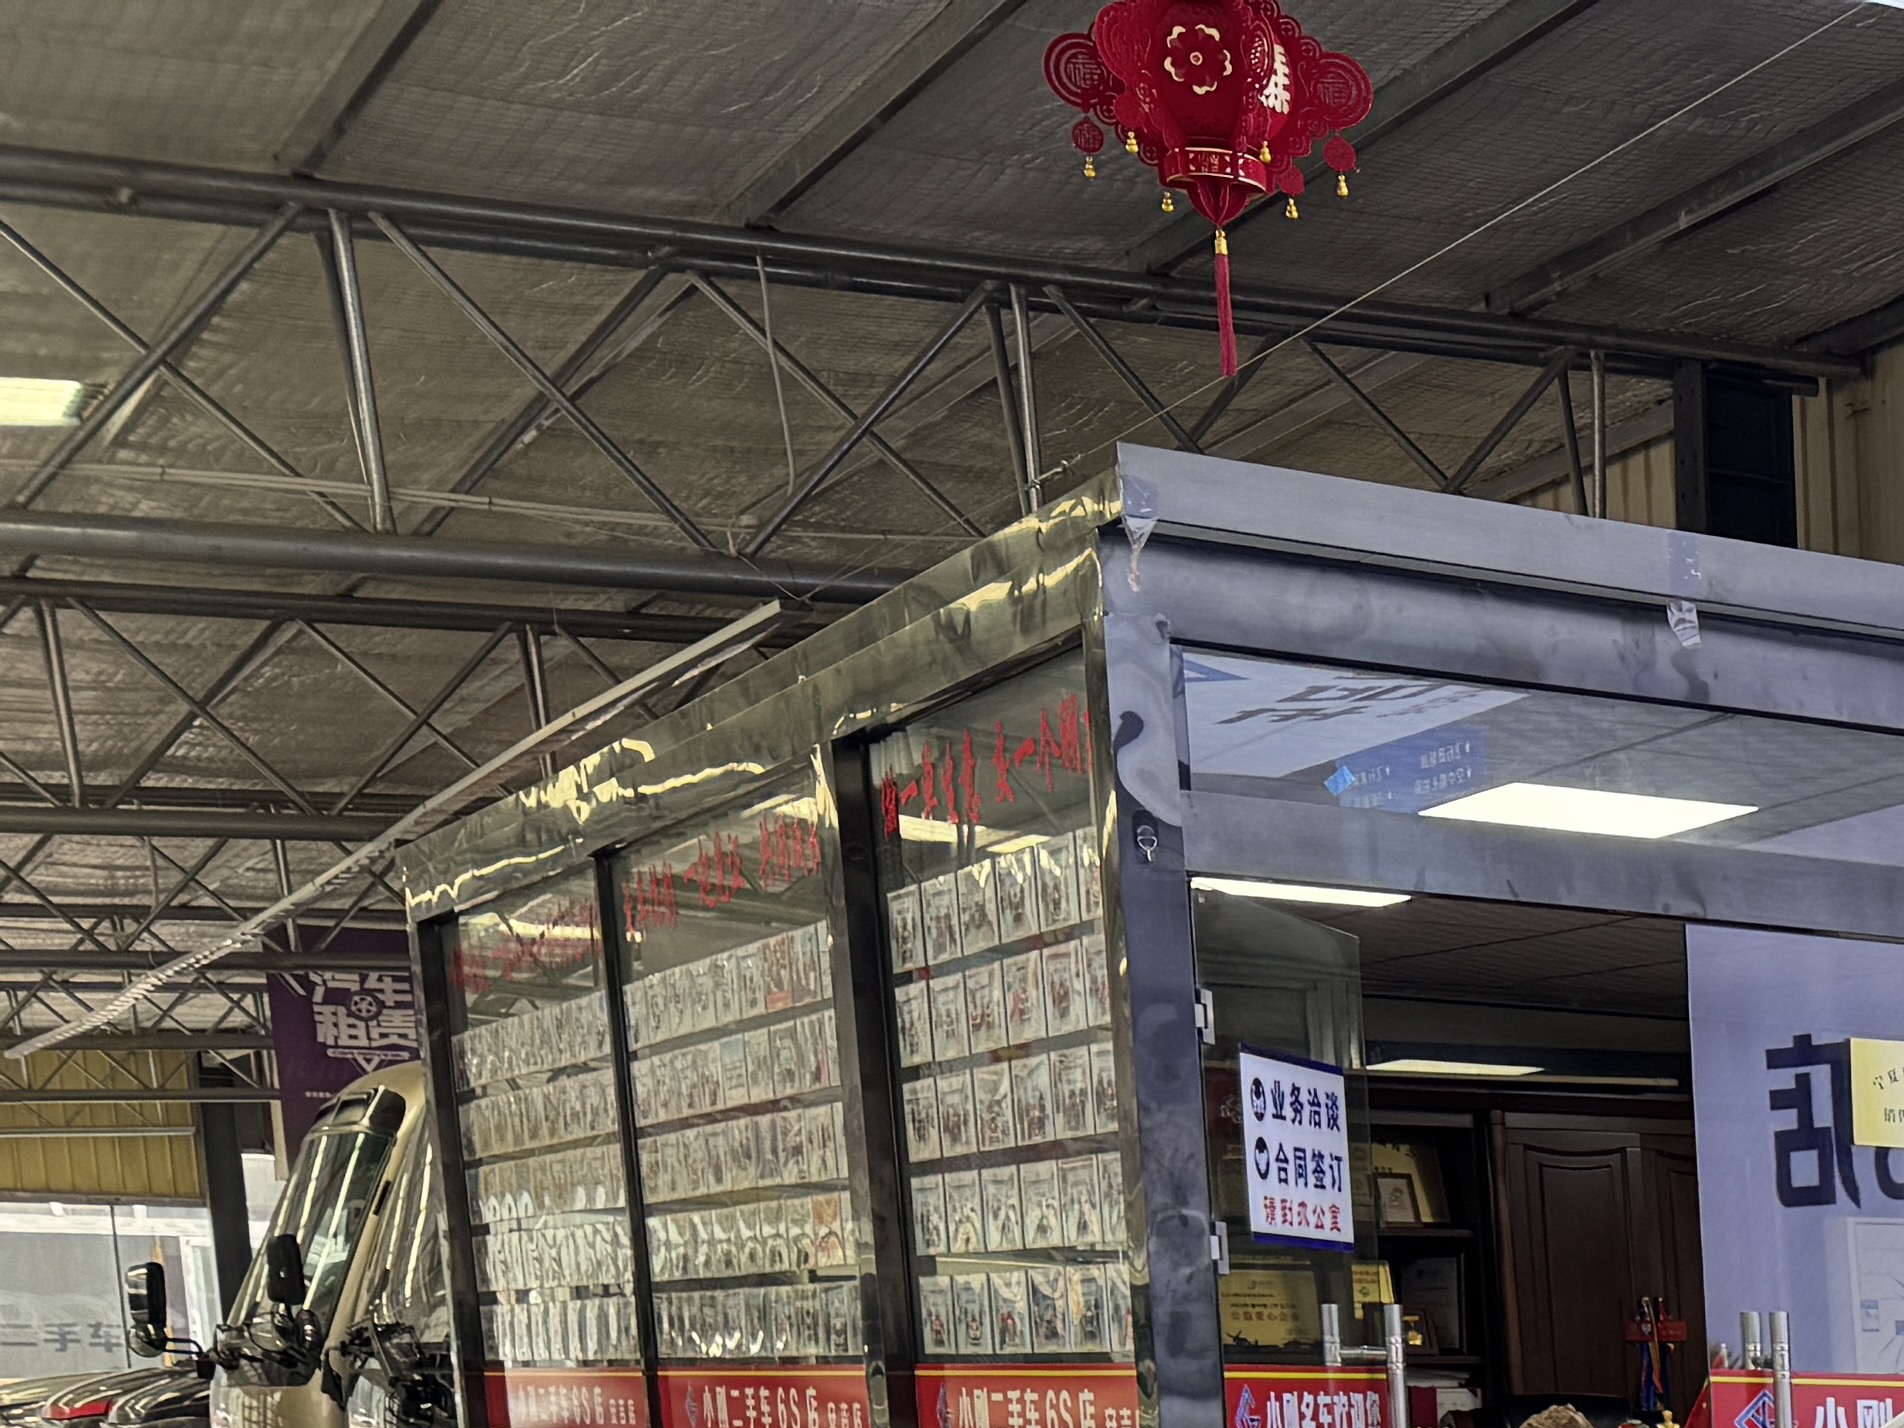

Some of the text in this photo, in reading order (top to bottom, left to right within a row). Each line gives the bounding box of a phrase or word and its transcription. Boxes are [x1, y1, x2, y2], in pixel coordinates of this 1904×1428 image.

[1270, 1080, 1341, 1132] 业务洽谈
[1274, 1142, 1344, 1193] 合同签订
